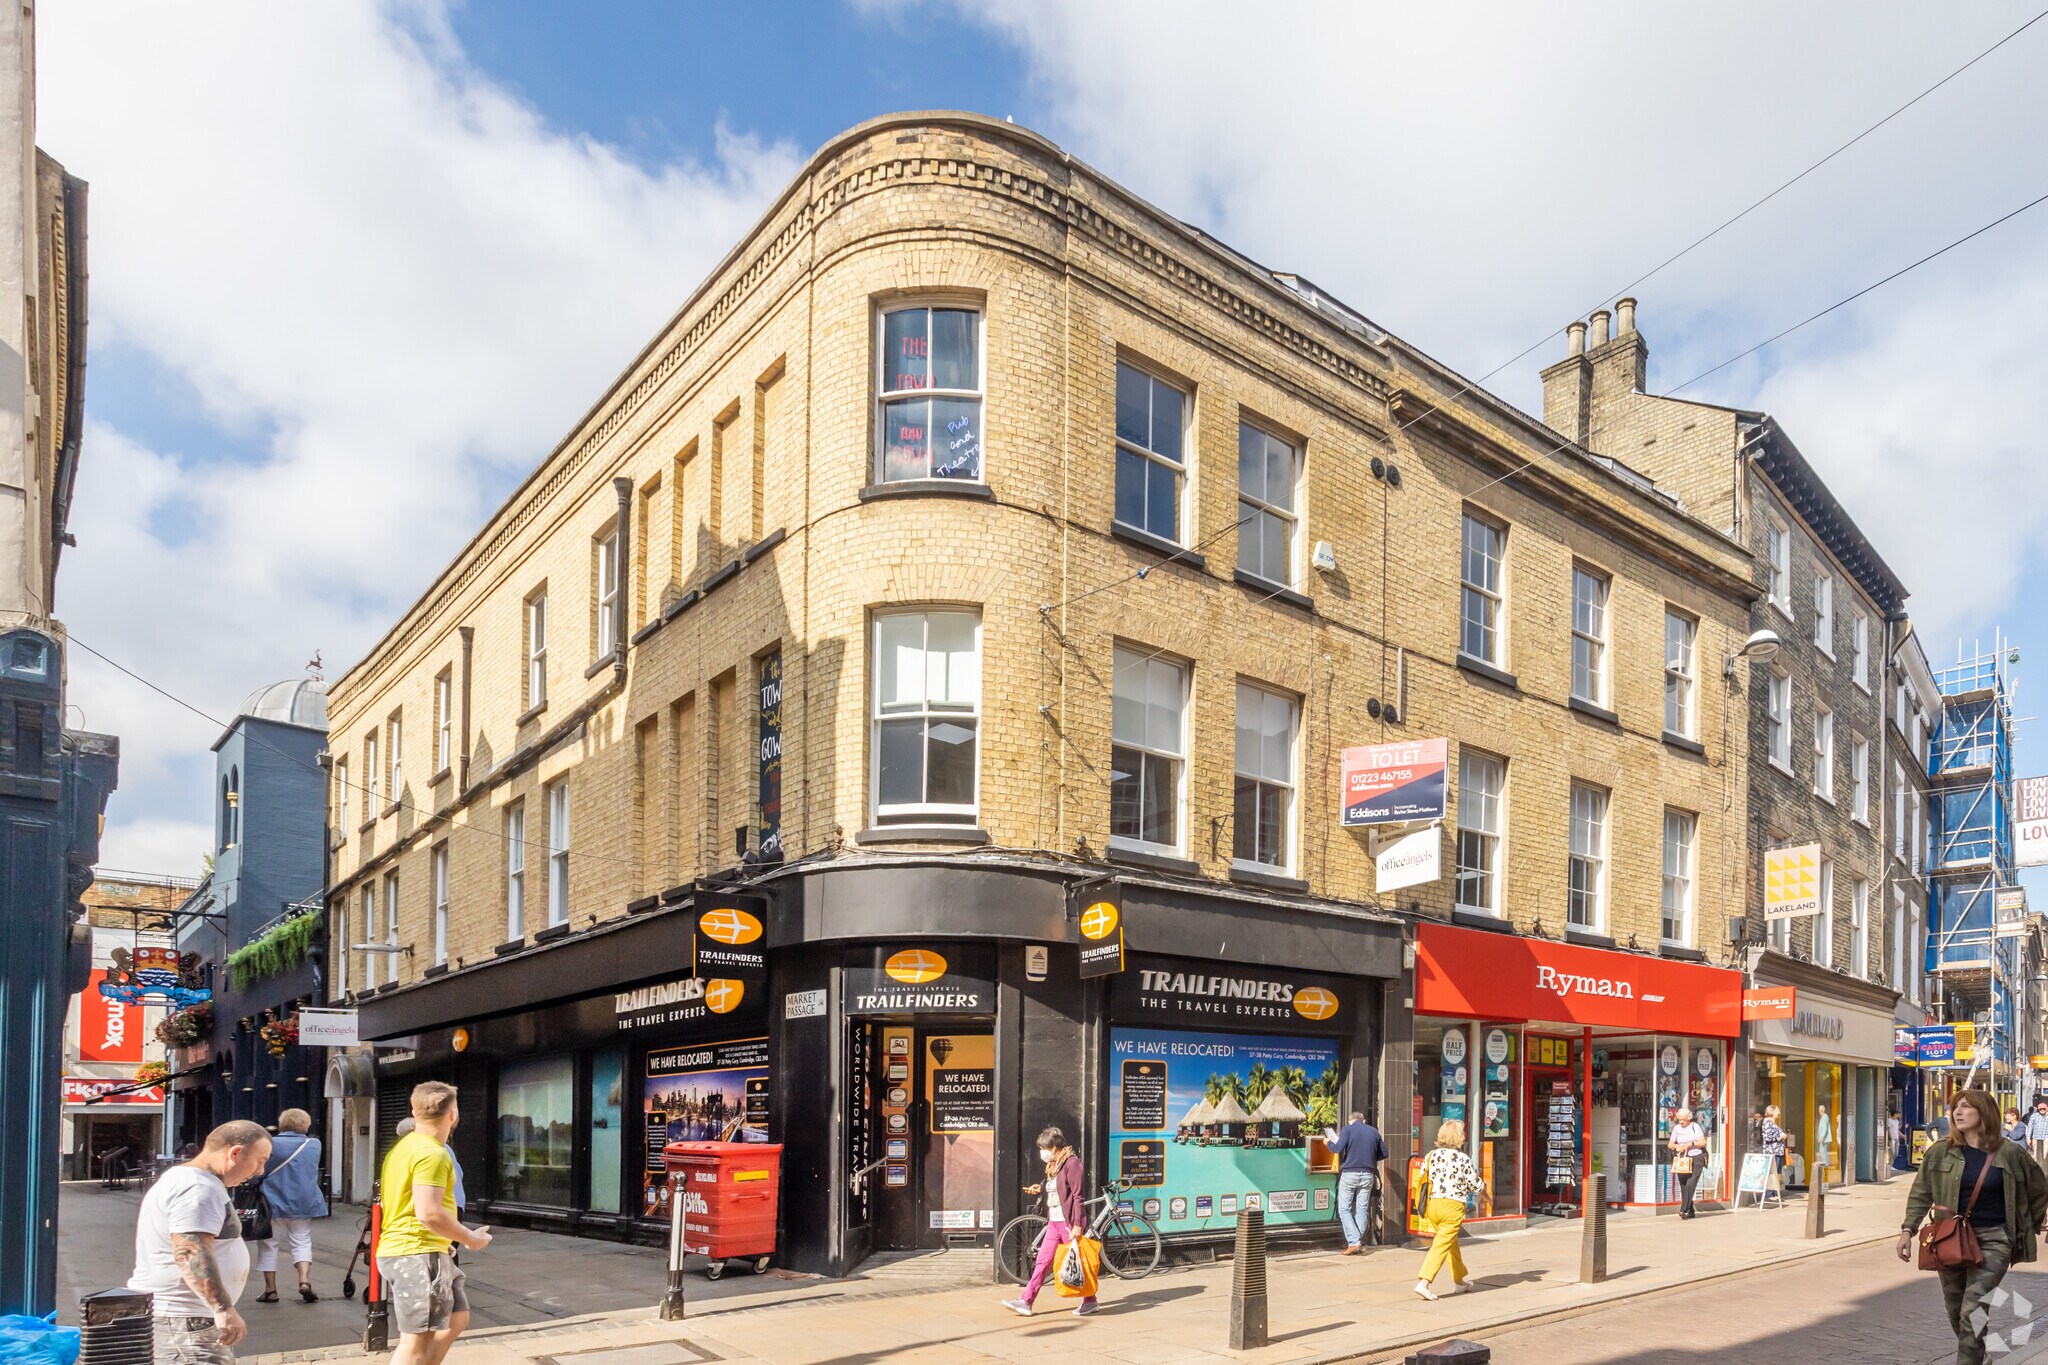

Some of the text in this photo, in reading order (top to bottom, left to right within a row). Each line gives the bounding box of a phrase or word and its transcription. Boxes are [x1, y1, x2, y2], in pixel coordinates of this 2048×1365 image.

[902, 336, 928, 356] THE
[947, 416, 969, 434] Pub
[951, 431, 975, 450] and
[937, 444, 981, 477] Theatre
[761, 679, 782, 710] TOW
[761, 733, 782, 762] GOW
[1371, 749, 1420, 768] TO LET
[1351, 769, 1412, 784] 01223 467155
[2023, 777, 2048, 790] LOV
[1351, 783, 1394, 792] eddisons.com
[2023, 788, 2048, 799] LOV
[2023, 798, 2048, 810] LOV
[1350, 807, 1389, 818] Eddisons
[2023, 807, 2048, 820] LOV
[1767, 901, 1816, 914] LAKELAND
[700, 951, 763, 963] TRAILFINDERS
[1081, 944, 1119, 959] TRAILFINDERS
[1140, 969, 1294, 1003] TRAILFINDERS
[1536, 965, 1634, 999] Ryman
[615, 977, 706, 1014] TRAILFINDERS
[787, 992, 817, 1005] MARKET
[857, 994, 978, 1009] TRAILFINDERS
[1743, 997, 1791, 1008] Ryman
[787, 1004, 815, 1016] PASSAGE
[1141, 997, 1291, 1018] THE TRAVEL EXPERTS
[101, 997, 125, 1050] maxx
[619, 1006, 706, 1030] THE TRAVEL EXPERTS
[305, 1025, 356, 1035] officeangels
[1790, 1011, 1844, 1041] LAKELAND
[1920, 1031, 1954, 1039] ADMIRAL
[1114, 1040, 1134, 1053] WE
[1137, 1041, 1167, 1055] HAVE
[1171, 1042, 1235, 1057] RELOCATED!
[1446, 1041, 1462, 1049] HALF
[1921, 1043, 1954, 1051] CASINO
[650, 1057, 660, 1069] WE
[661, 1054, 676, 1069] HAVE
[677, 1051, 714, 1067] RELOCATED!
[1664, 1061, 1676, 1069] FREE
[1699, 1063, 1710, 1071] FREE
[853, 1027, 861, 1127] WORLDWIDE
[945, 1073, 985, 1083] WE HAVE
[938, 1084, 990, 1093] RELOCATED!
